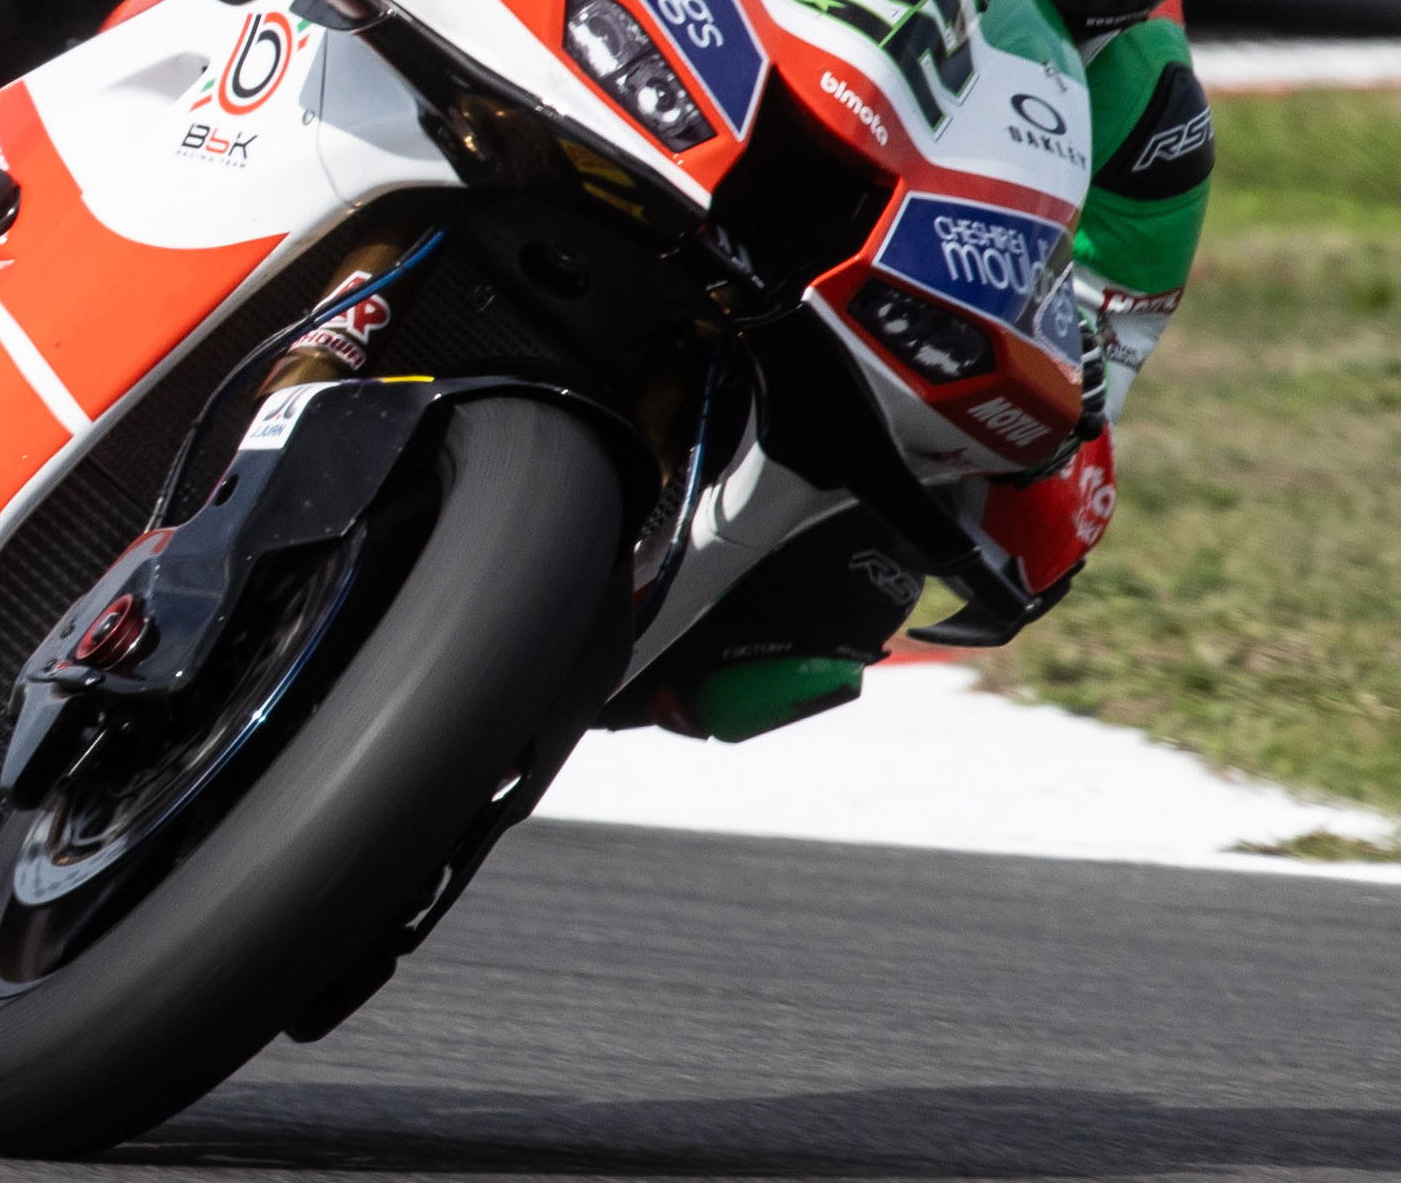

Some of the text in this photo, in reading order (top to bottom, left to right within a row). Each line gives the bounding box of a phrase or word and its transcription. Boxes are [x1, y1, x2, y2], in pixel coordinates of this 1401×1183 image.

[819, 70, 891, 148] bimota
[1009, 124, 1089, 172] OAKLEY
[289, 329, 366, 370] HOWA
[966, 396, 1053, 448] MOTUL
